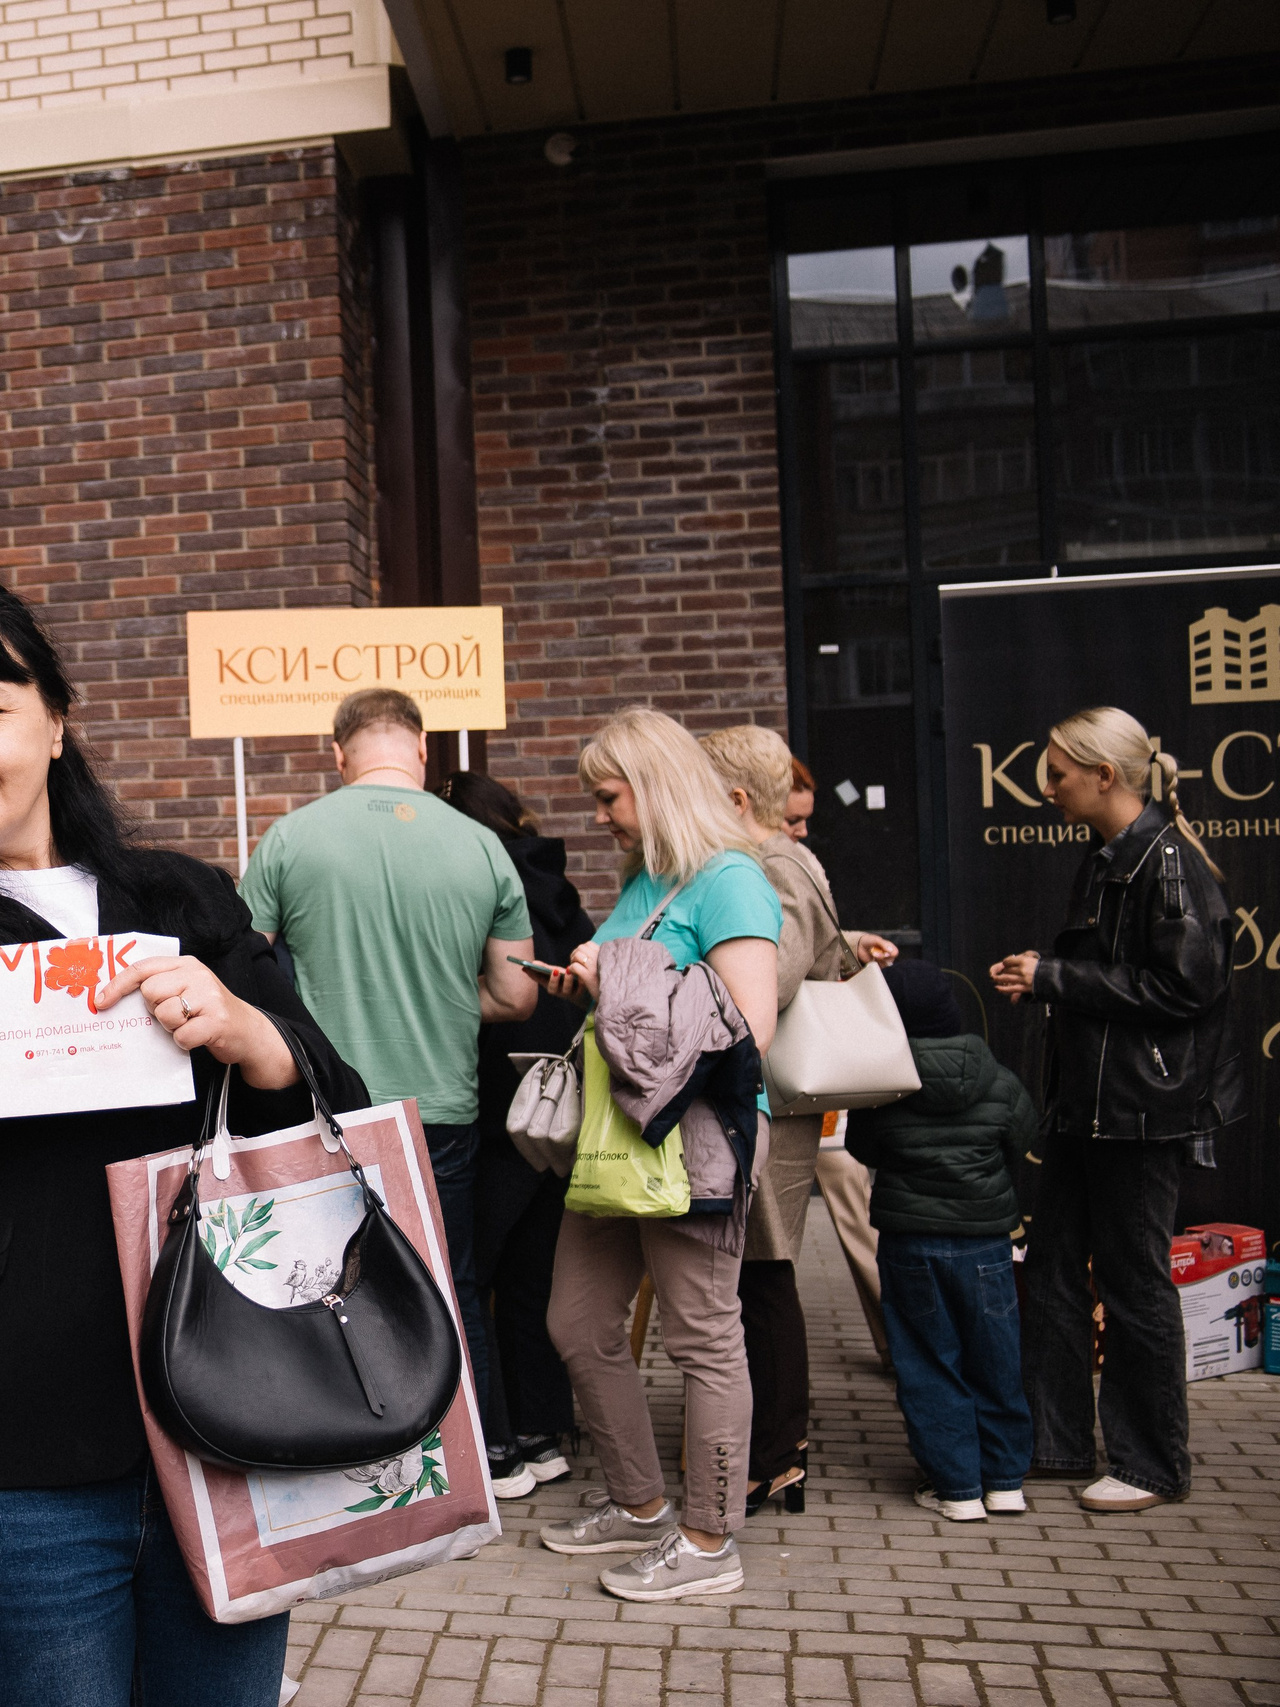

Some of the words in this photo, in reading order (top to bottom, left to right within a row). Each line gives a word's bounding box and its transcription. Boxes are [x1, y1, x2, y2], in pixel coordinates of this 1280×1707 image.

[215, 634, 482, 684] КСИ-СТРОЙ
[219, 691, 353, 705] специализирова
[35, 1019, 115, 1039] домашнего
[117, 1016, 152, 1032] уюта
[36, 1048, 65, 1057] 971-741
[80, 1042, 122, 1053] mak_irkutsk
